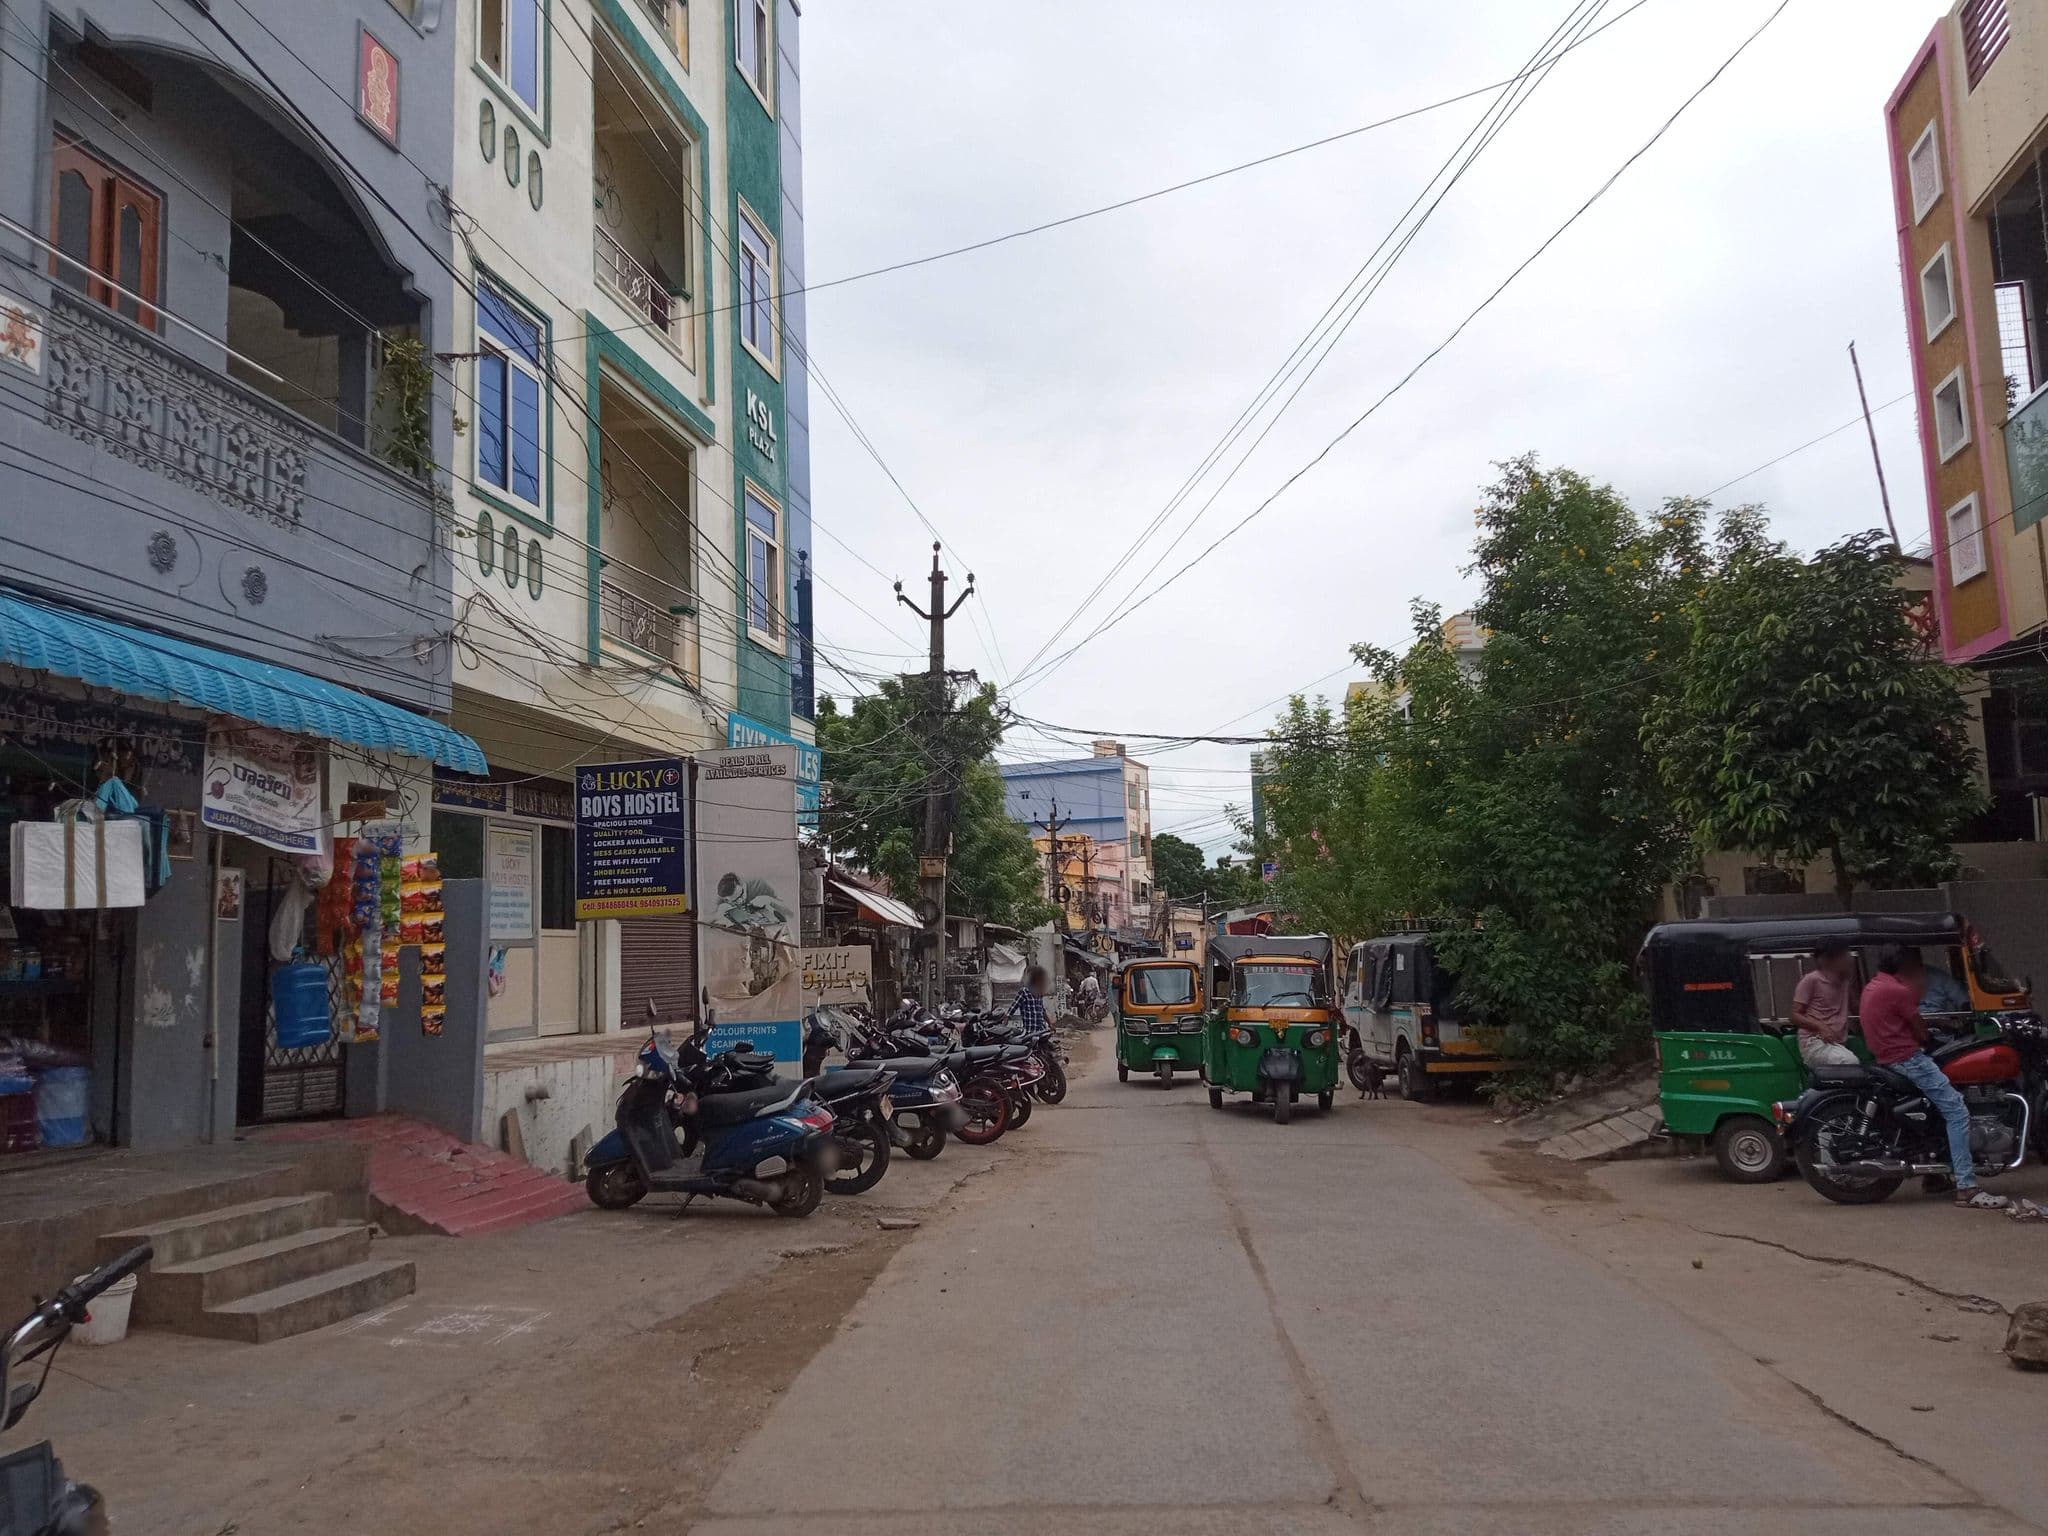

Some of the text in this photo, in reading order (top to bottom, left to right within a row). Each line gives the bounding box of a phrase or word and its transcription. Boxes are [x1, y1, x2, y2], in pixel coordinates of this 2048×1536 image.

[746, 386, 777, 442] KSL
[748, 426, 775, 463] PLAZA
[719, 754, 771, 768] DEALS IN ALL
[705, 763, 787, 780] AVAILABLE SERVICES
[596, 769, 663, 791] LUCKY
[581, 791, 680, 817] BOYS HOSTEL
[593, 819, 653, 828] SPACIOUS ROOMS
[593, 830, 622, 838] QUALITY
[285, 833, 310, 848] HERE
[626, 837, 664, 846] AVAILABLE
[593, 846, 676, 857] MESS CARDS AVAILABLE
[613, 858, 630, 866] WI-FI
[630, 857, 661, 865] FACILITY
[593, 867, 647, 876] DHOBI FACILITY
[613, 876, 654, 885] TRANSPORT
[613, 887, 628, 895] NON
[642, 886, 667, 894] ROOMS
[802, 952, 850, 971] FIXIT
[802, 969, 868, 990] OBILES
[711, 1025, 777, 1037] COLOUR PRINTS
[1681, 1050, 1689, 1060] 4
[1708, 1050, 1736, 1060] ALL
